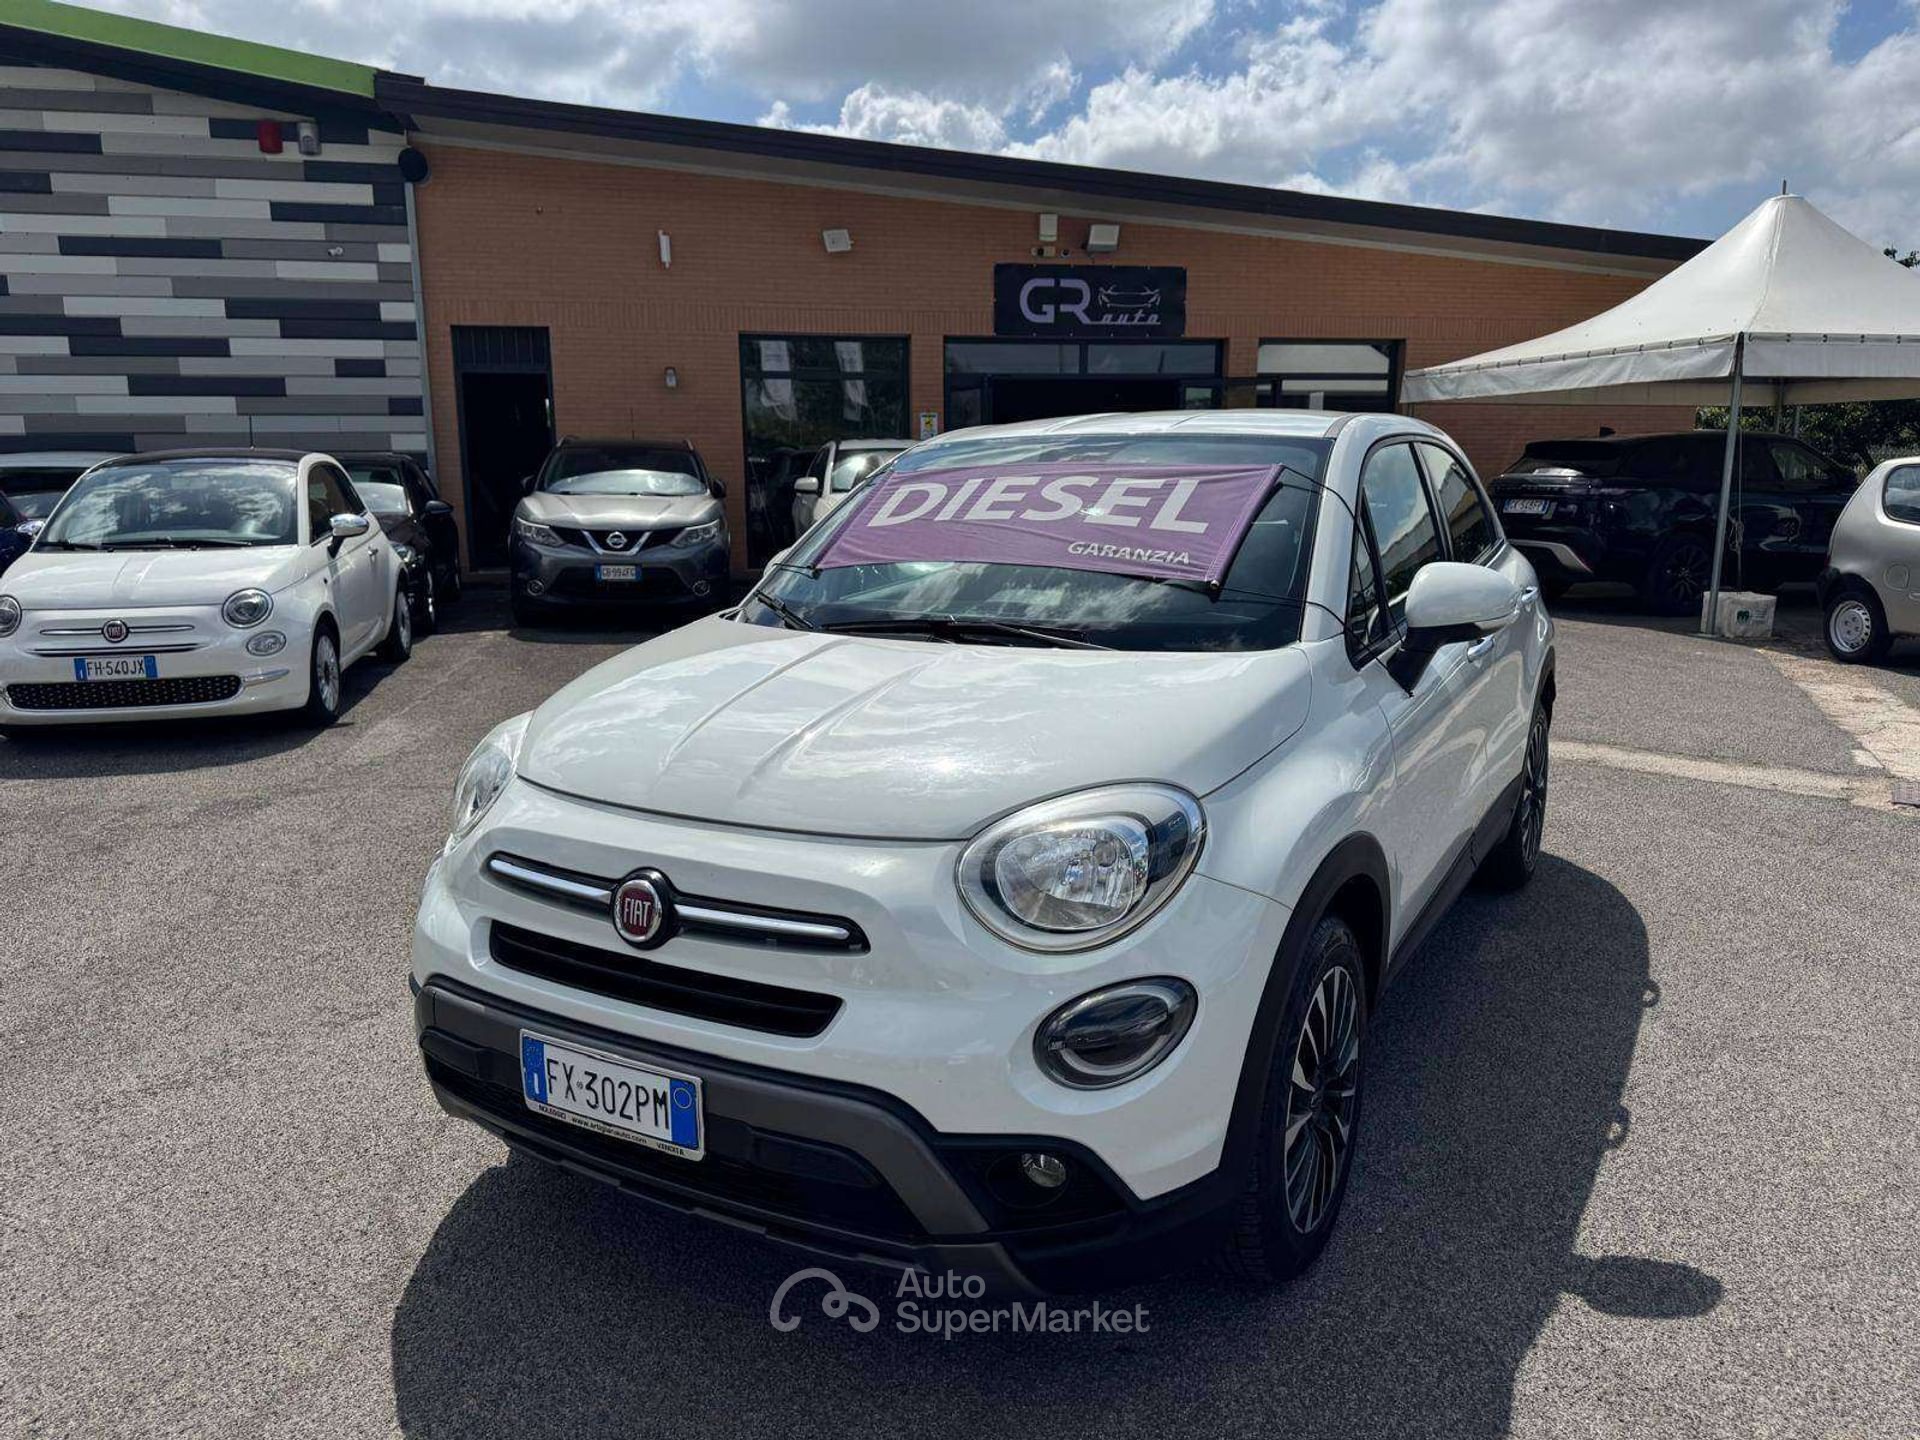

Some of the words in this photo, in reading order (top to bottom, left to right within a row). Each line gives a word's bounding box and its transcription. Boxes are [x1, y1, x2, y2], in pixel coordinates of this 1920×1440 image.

[1019, 277, 1092, 325] GR
[1100, 308, 1160, 325] auto
[867, 475, 1209, 534] DIESEL
[1067, 540, 1191, 566] GARANZIA
[623, 897, 651, 928] FIAT
